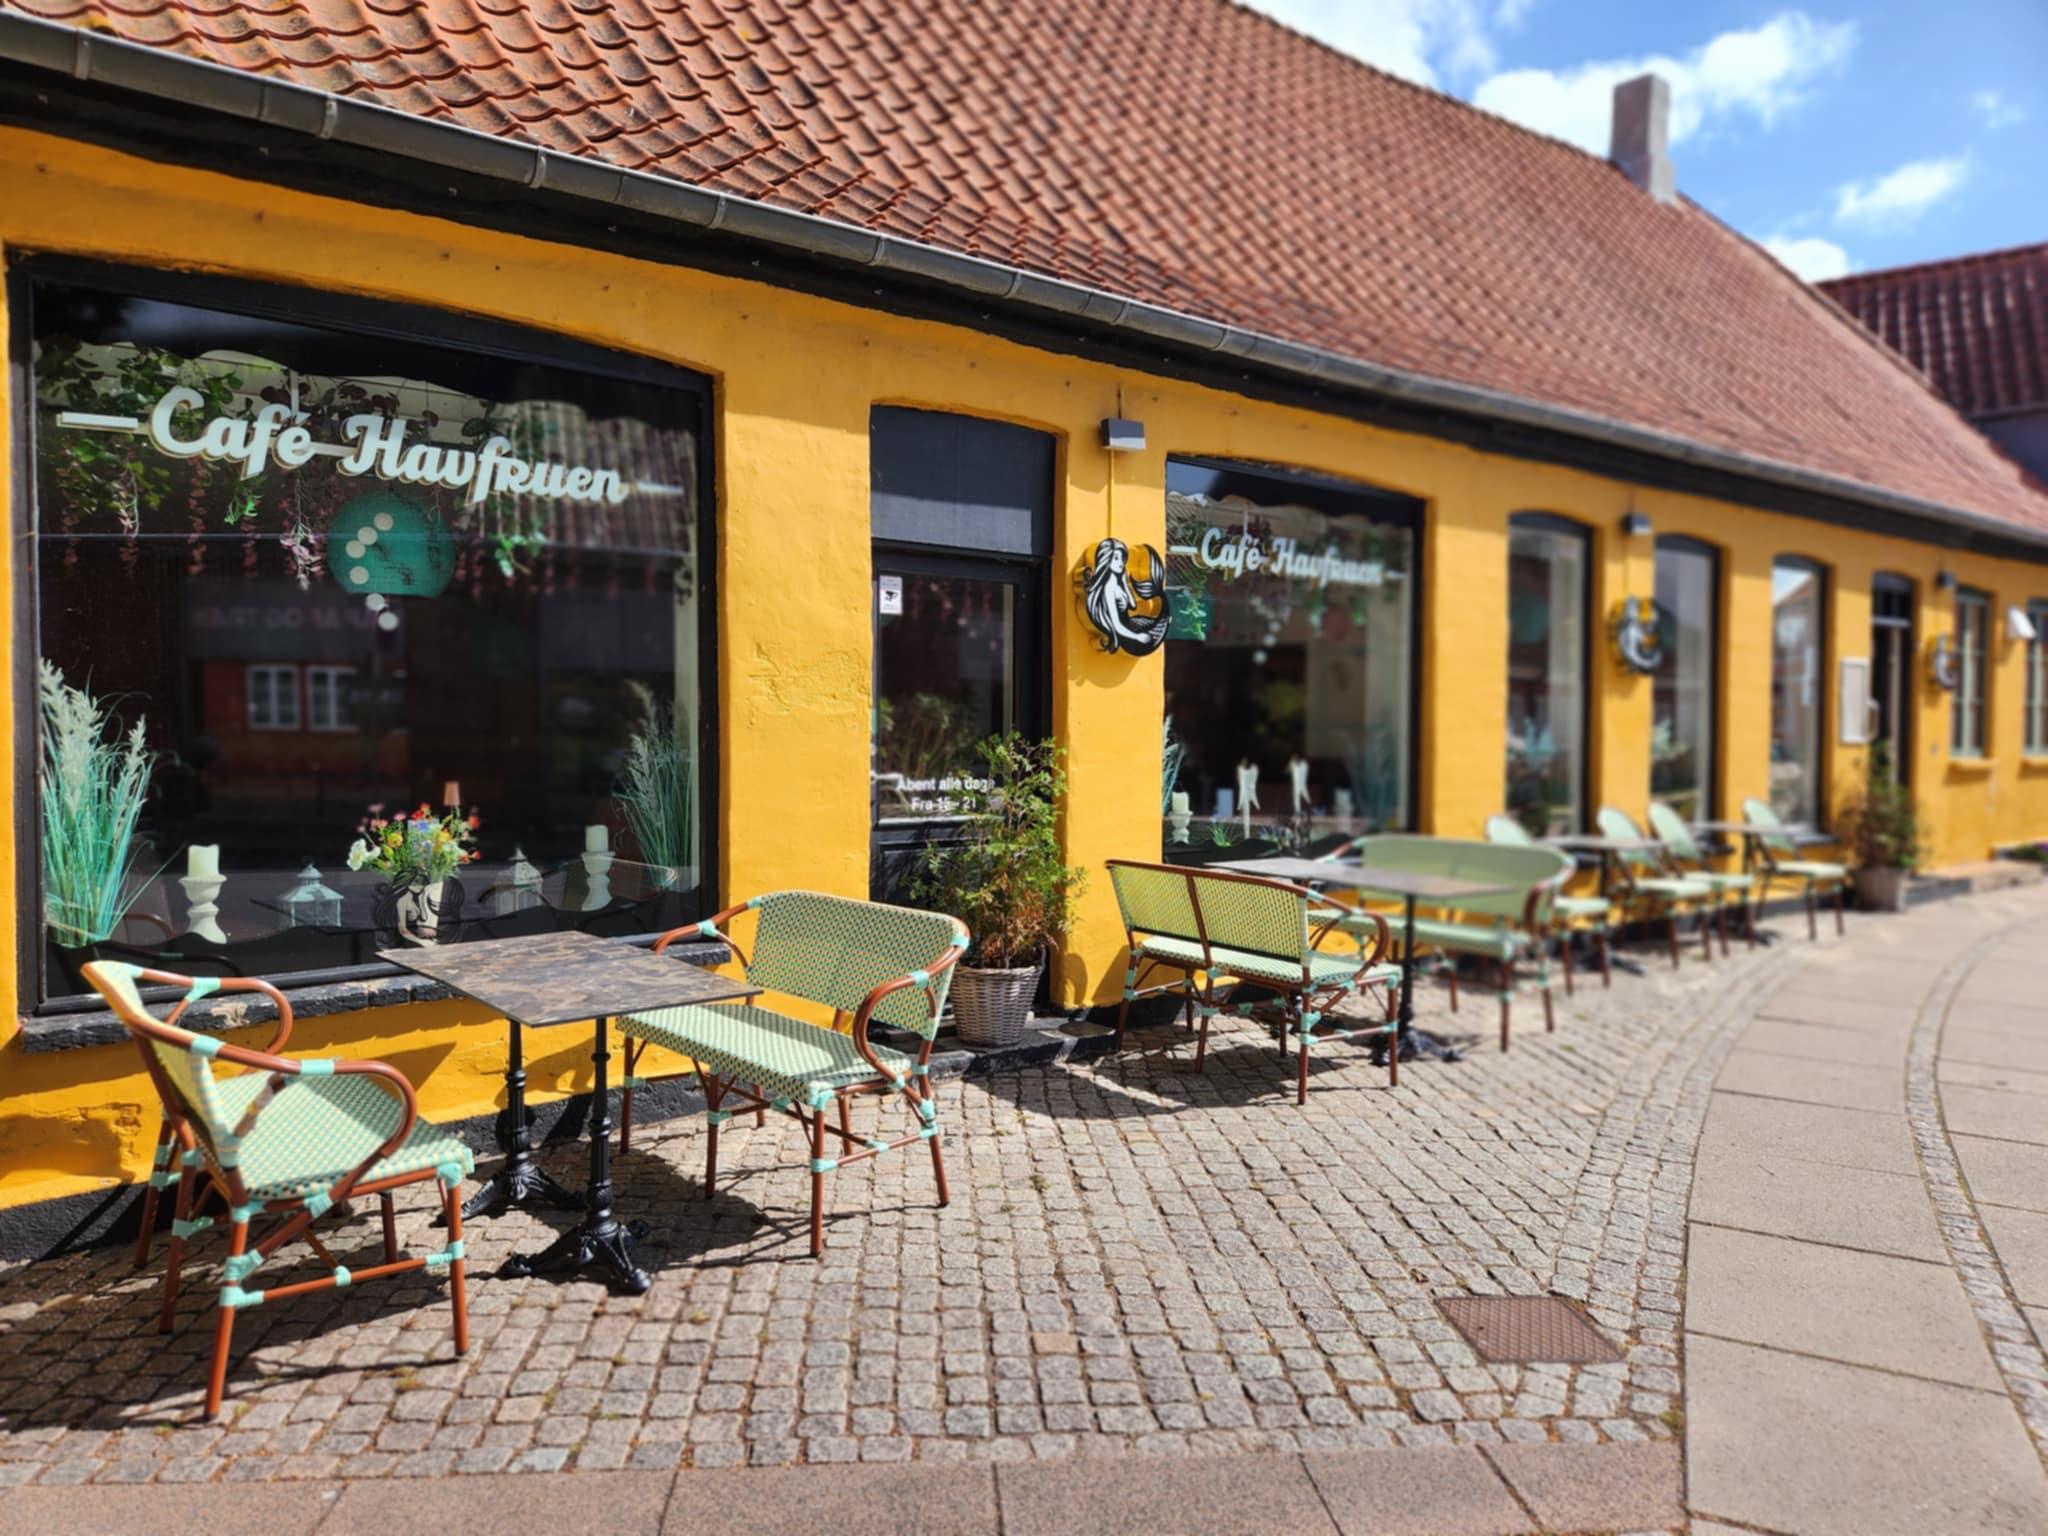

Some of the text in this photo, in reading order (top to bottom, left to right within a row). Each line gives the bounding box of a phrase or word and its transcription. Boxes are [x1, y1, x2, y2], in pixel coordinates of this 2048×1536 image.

[149, 386, 628, 505] Café Havfruen
[1201, 527, 1263, 578] Café
[911, 796, 933, 811] Fra
[963, 795, 977, 809] 21
